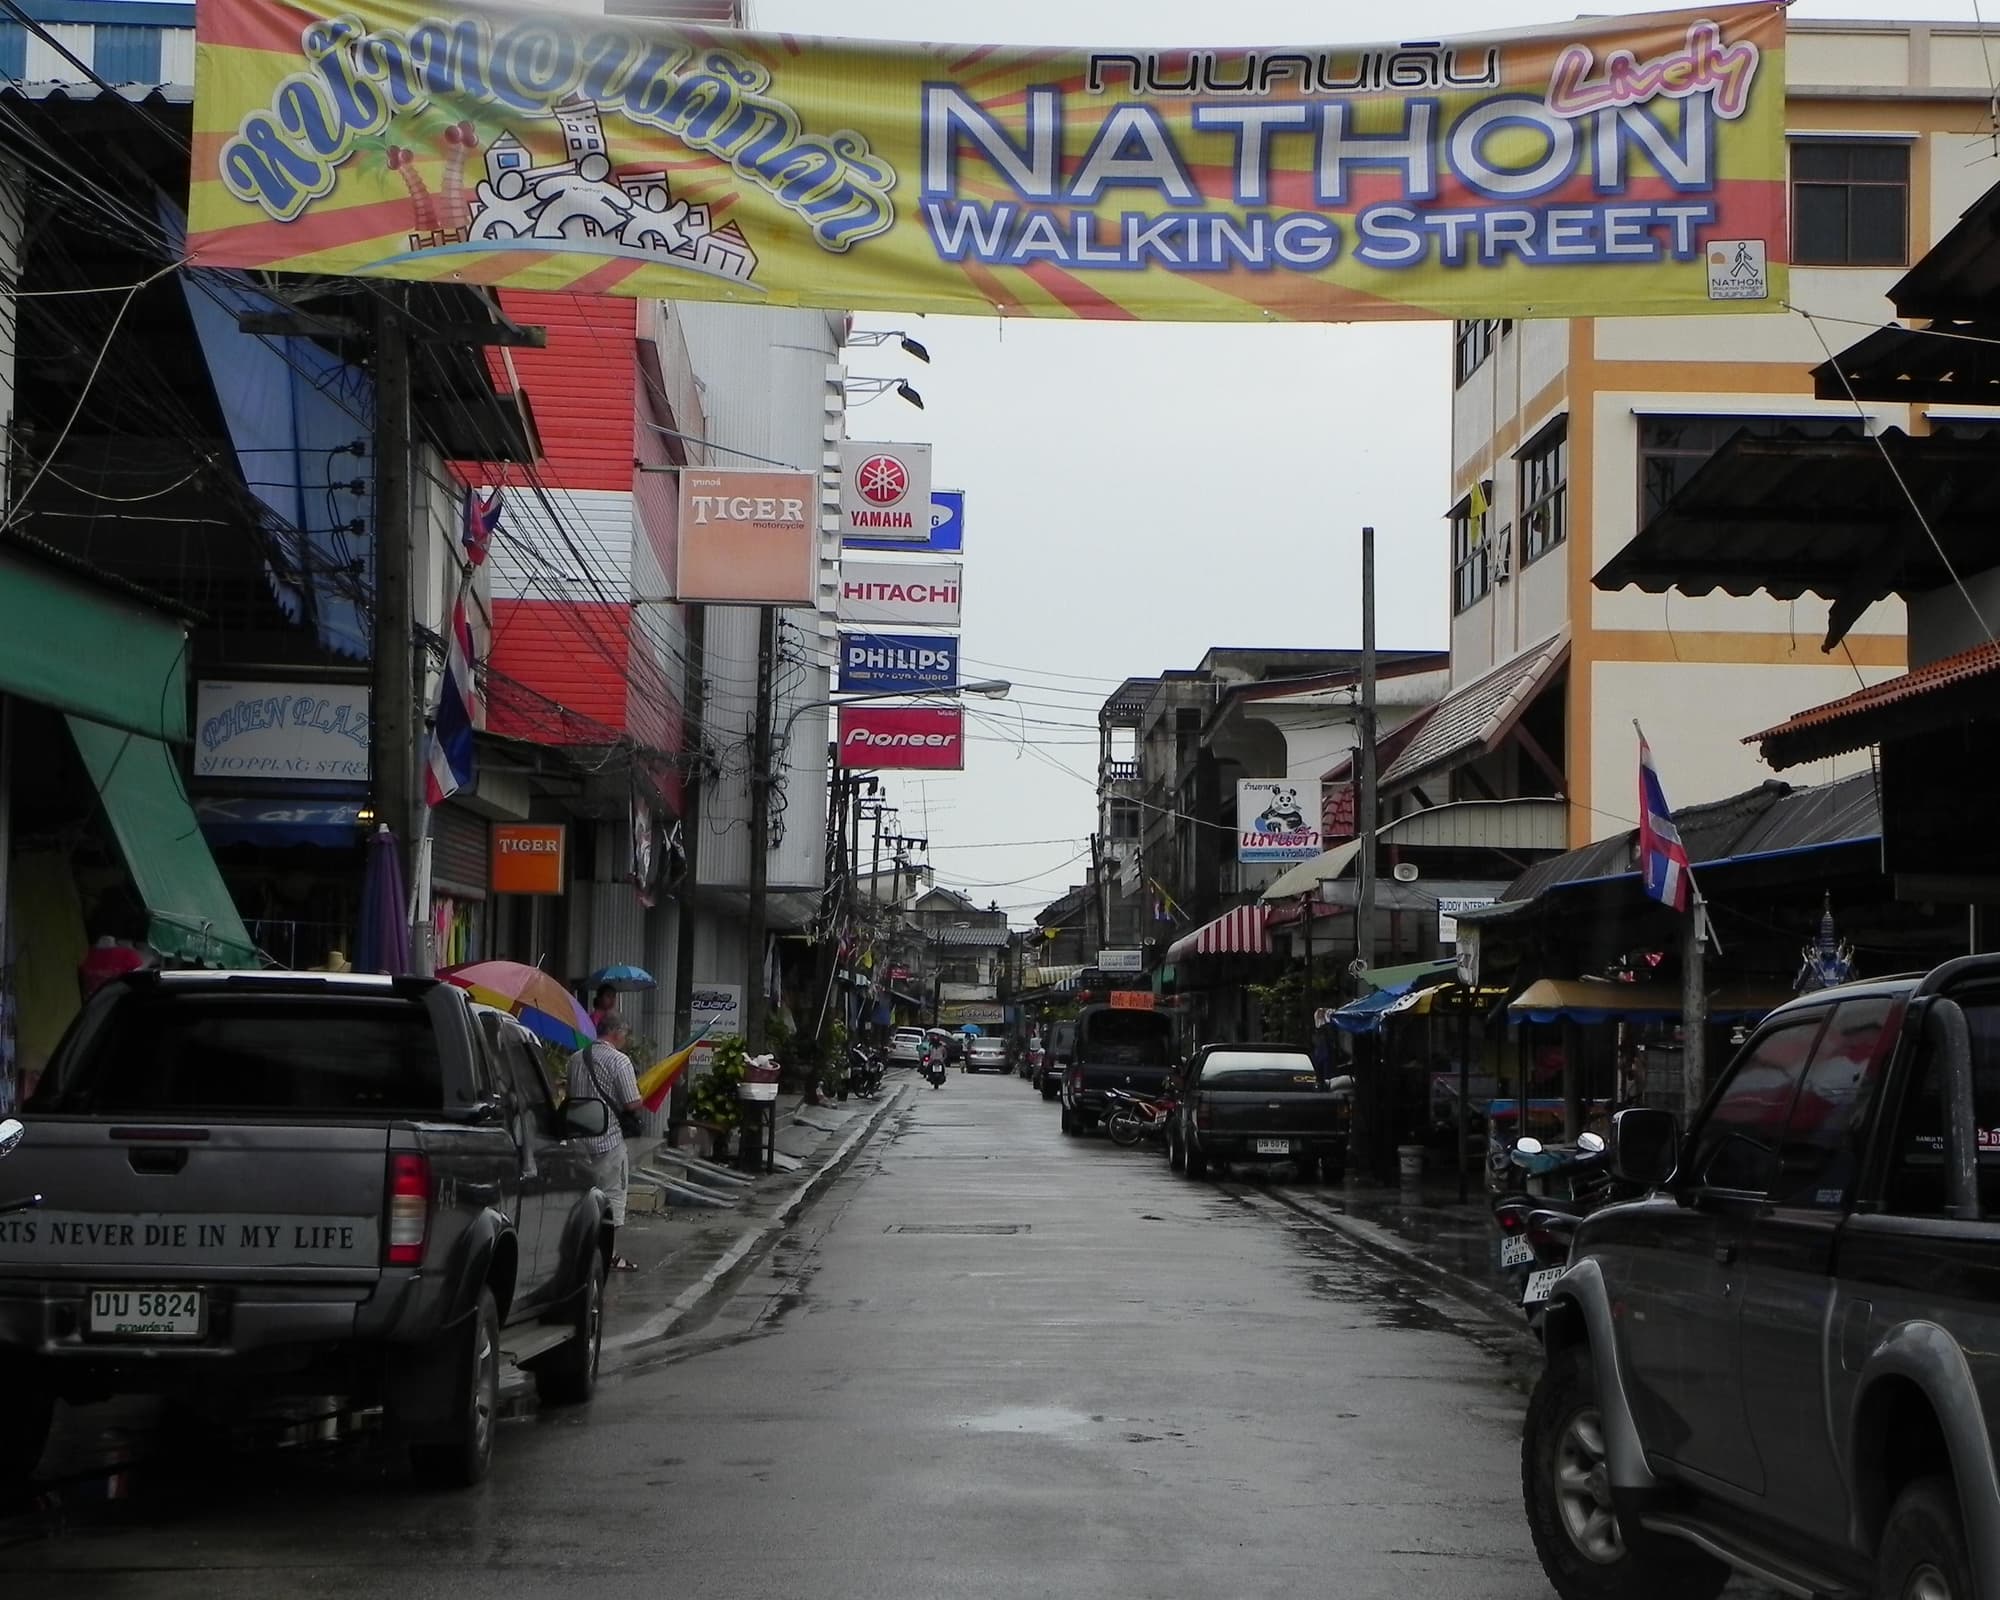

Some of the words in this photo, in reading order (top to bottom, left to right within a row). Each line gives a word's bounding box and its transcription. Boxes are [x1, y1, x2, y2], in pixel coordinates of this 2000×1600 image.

[1089, 41, 1497, 91] ถนนคนเดิน
[1549, 24, 1758, 116] Lively
[926, 87, 1709, 200] NATHON
[931, 202, 1335, 262] WALKING
[1361, 206, 1708, 260] STREET
[1712, 278, 1763, 287] NATHON
[692, 496, 804, 525] TIGER
[851, 511, 913, 528] YAMAHA
[752, 521, 805, 530] motorcycle
[844, 582, 957, 604] HITACHI
[849, 647, 950, 671] PHILIPS
[845, 728, 957, 746] Pioneer
[498, 838, 558, 854] TIGER
[1439, 901, 1461, 911] BUDDY
[50, 1222, 134, 1246] NEVER
[145, 1224, 187, 1247] DIE
[198, 1225, 225, 1247] IN
[240, 1226, 280, 1248] MY
[294, 1227, 353, 1249] LIFE
[138, 1293, 197, 1318] 5824
